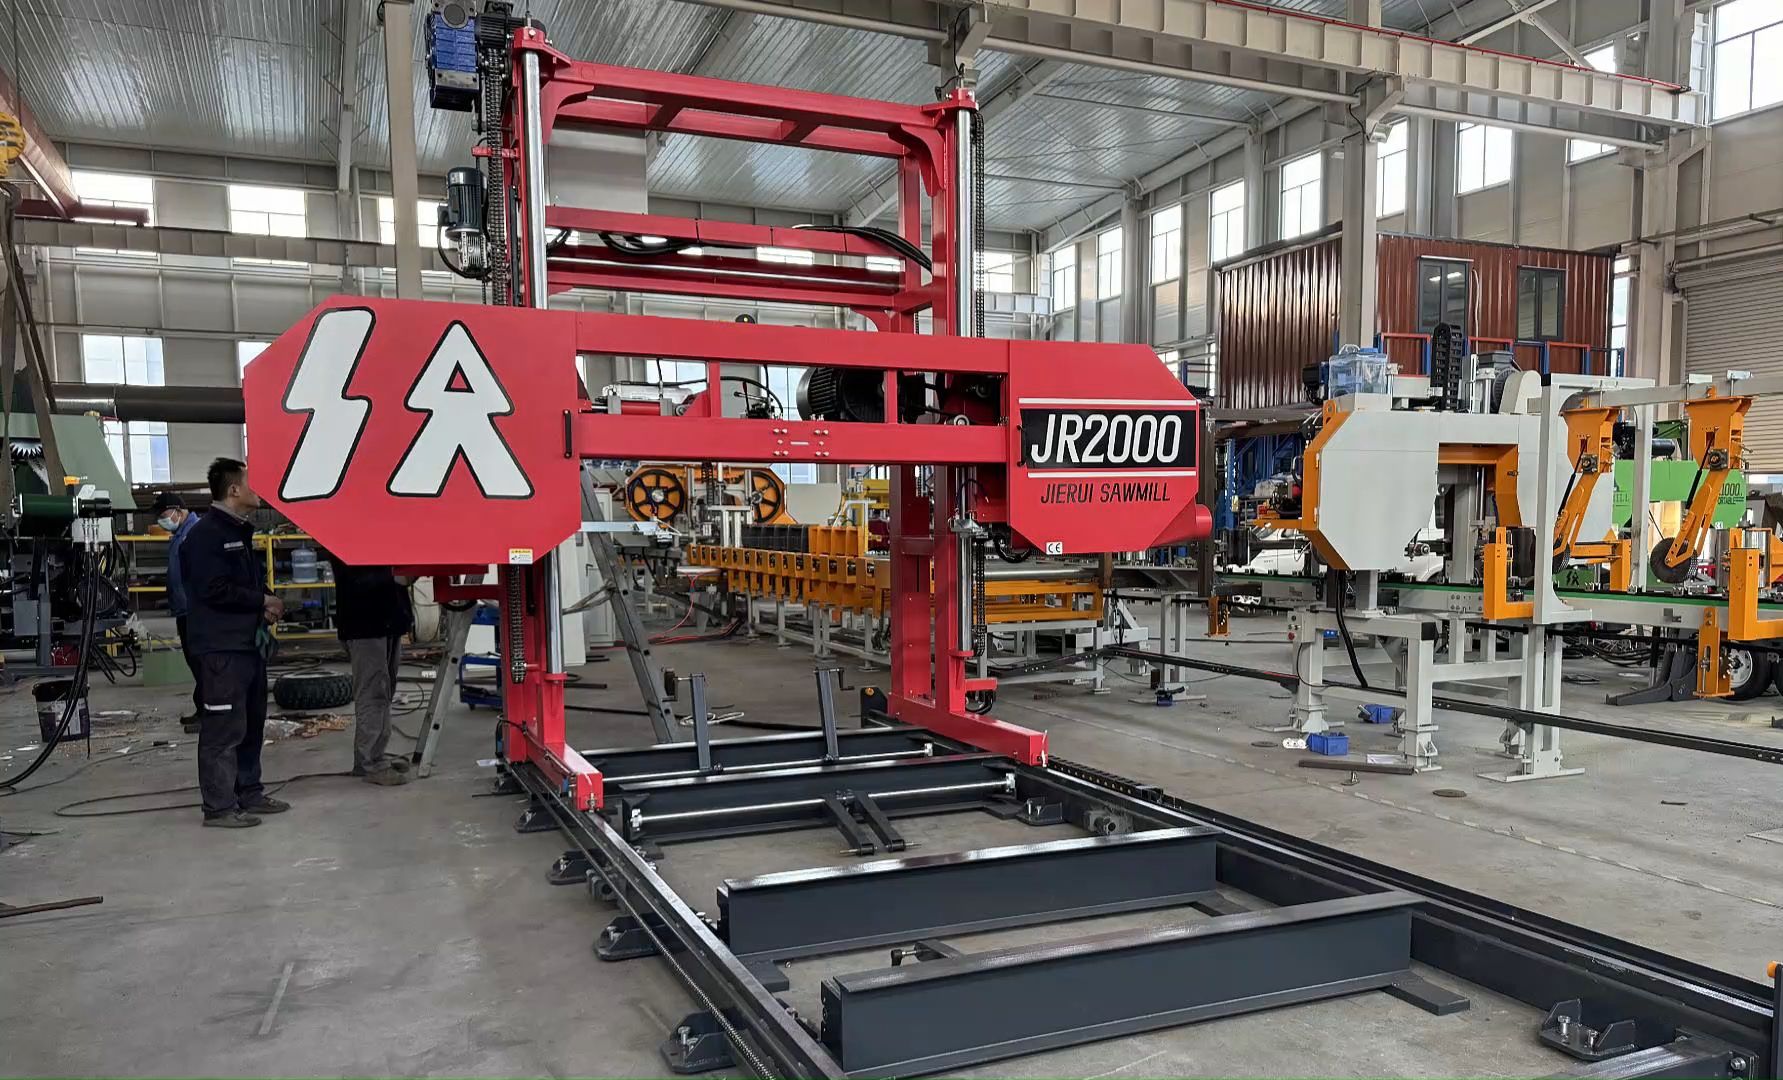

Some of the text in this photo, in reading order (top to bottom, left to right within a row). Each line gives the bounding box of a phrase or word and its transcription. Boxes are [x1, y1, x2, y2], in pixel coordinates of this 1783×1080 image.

[1030, 413, 1182, 464] JR2000
[1040, 482, 1171, 504] JIERUI SAWMILL
